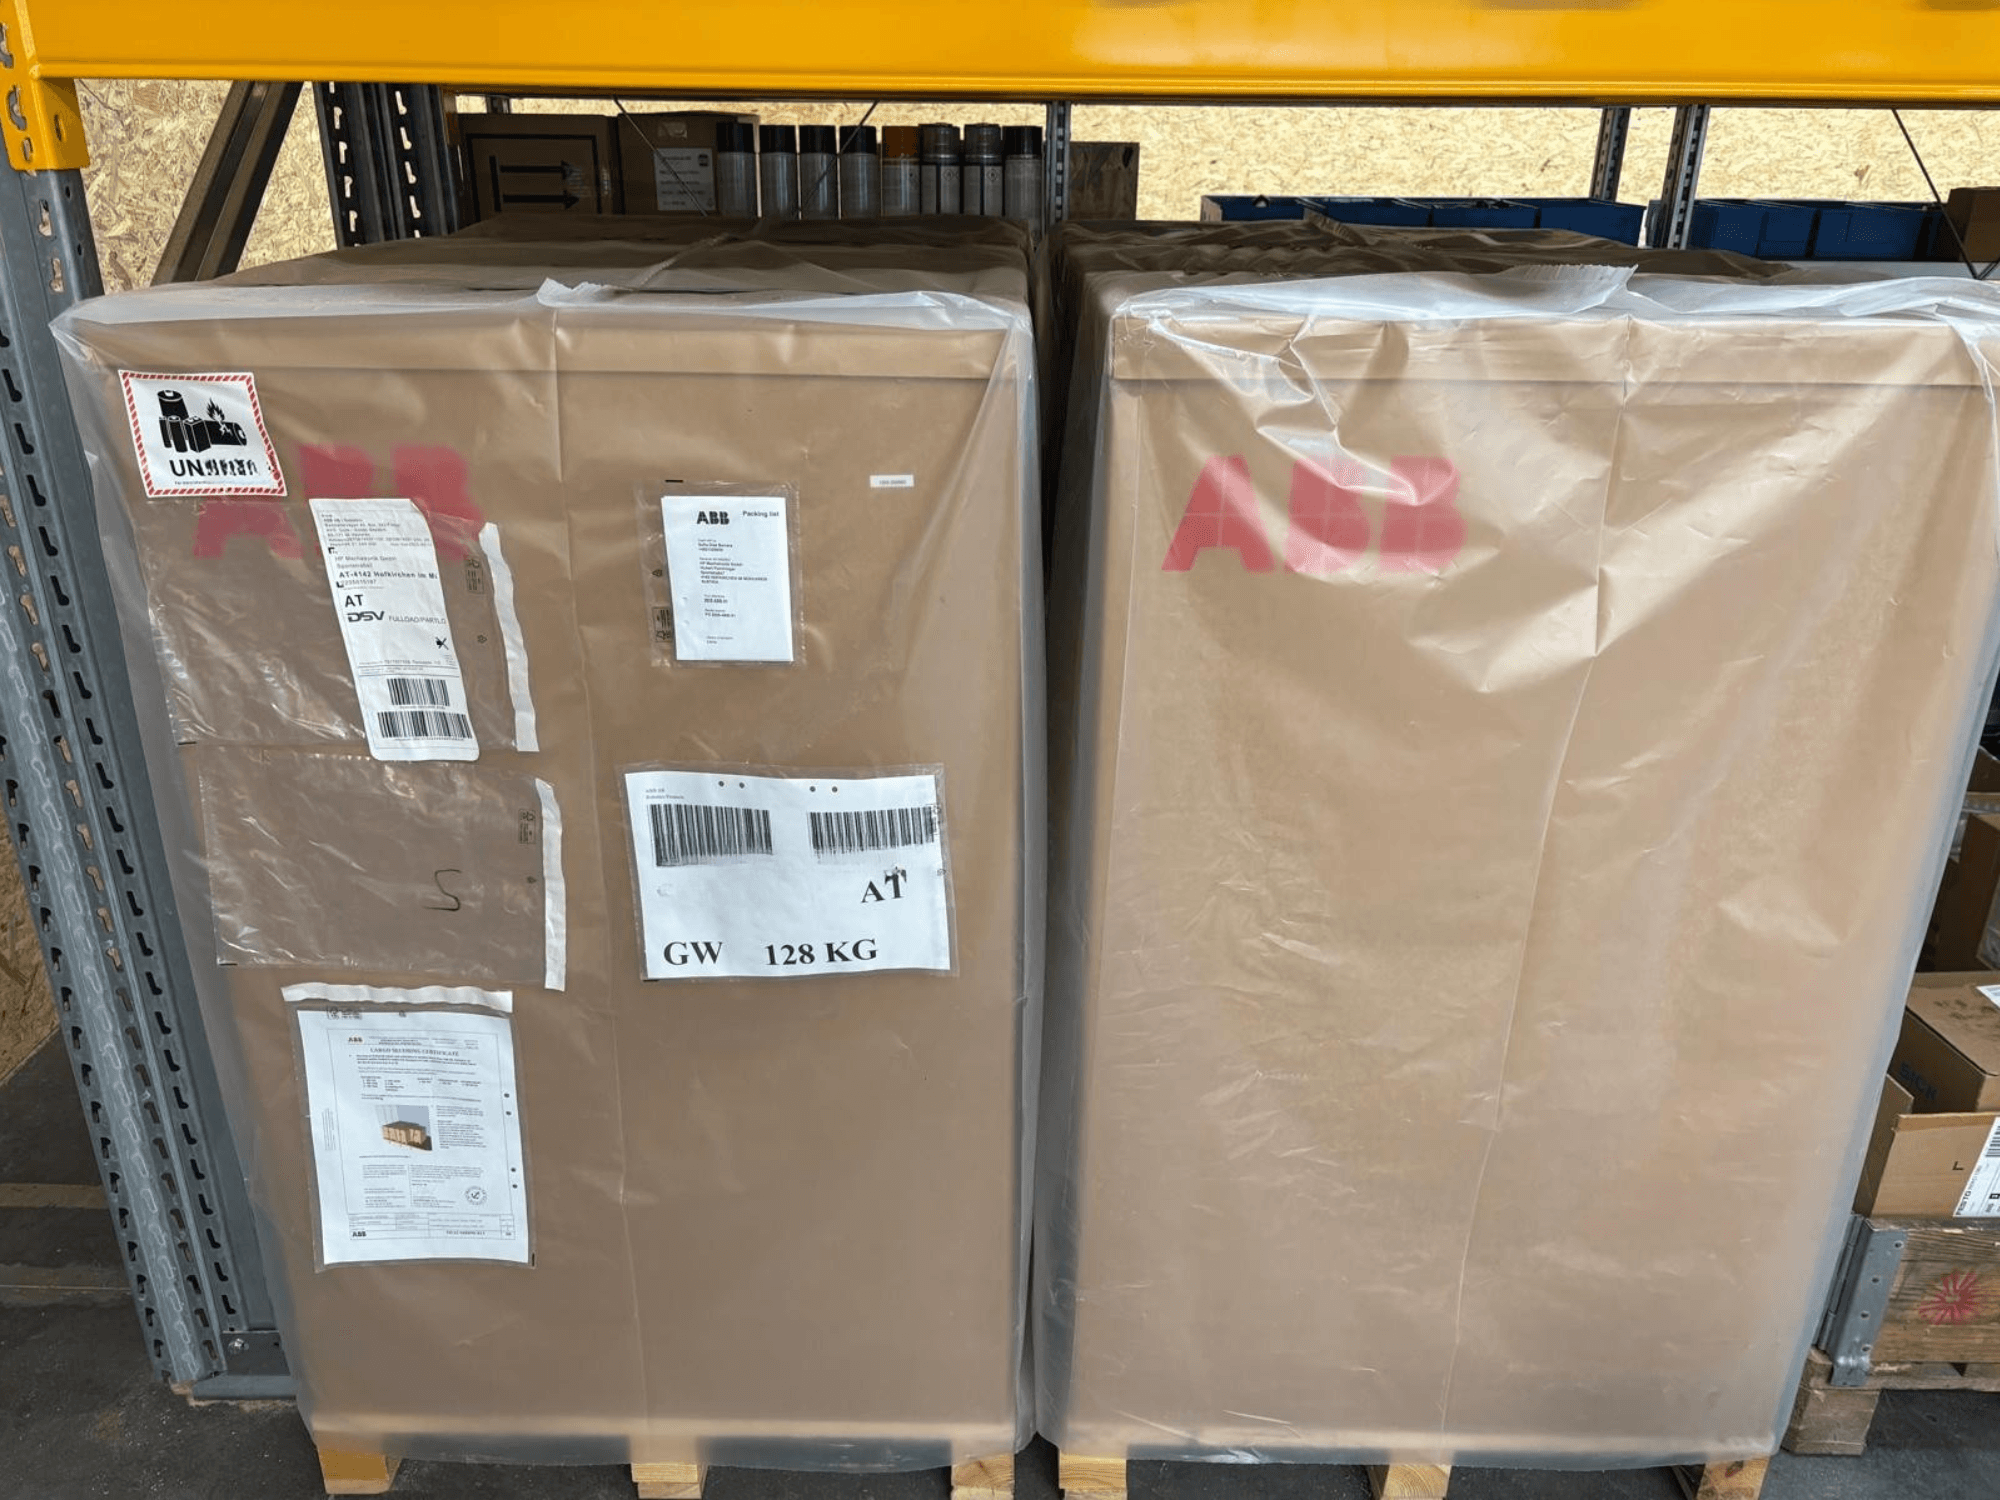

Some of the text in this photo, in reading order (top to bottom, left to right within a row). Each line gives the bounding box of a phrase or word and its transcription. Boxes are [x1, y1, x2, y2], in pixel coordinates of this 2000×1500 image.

[697, 511, 730, 525] ABB
[742, 510, 768, 518] Packing
[1161, 455, 1467, 576] ABB
[345, 594, 363, 607] AT
[347, 611, 385, 622] DSV
[861, 868, 907, 903] AT
[663, 938, 878, 966] GW 128 KG
